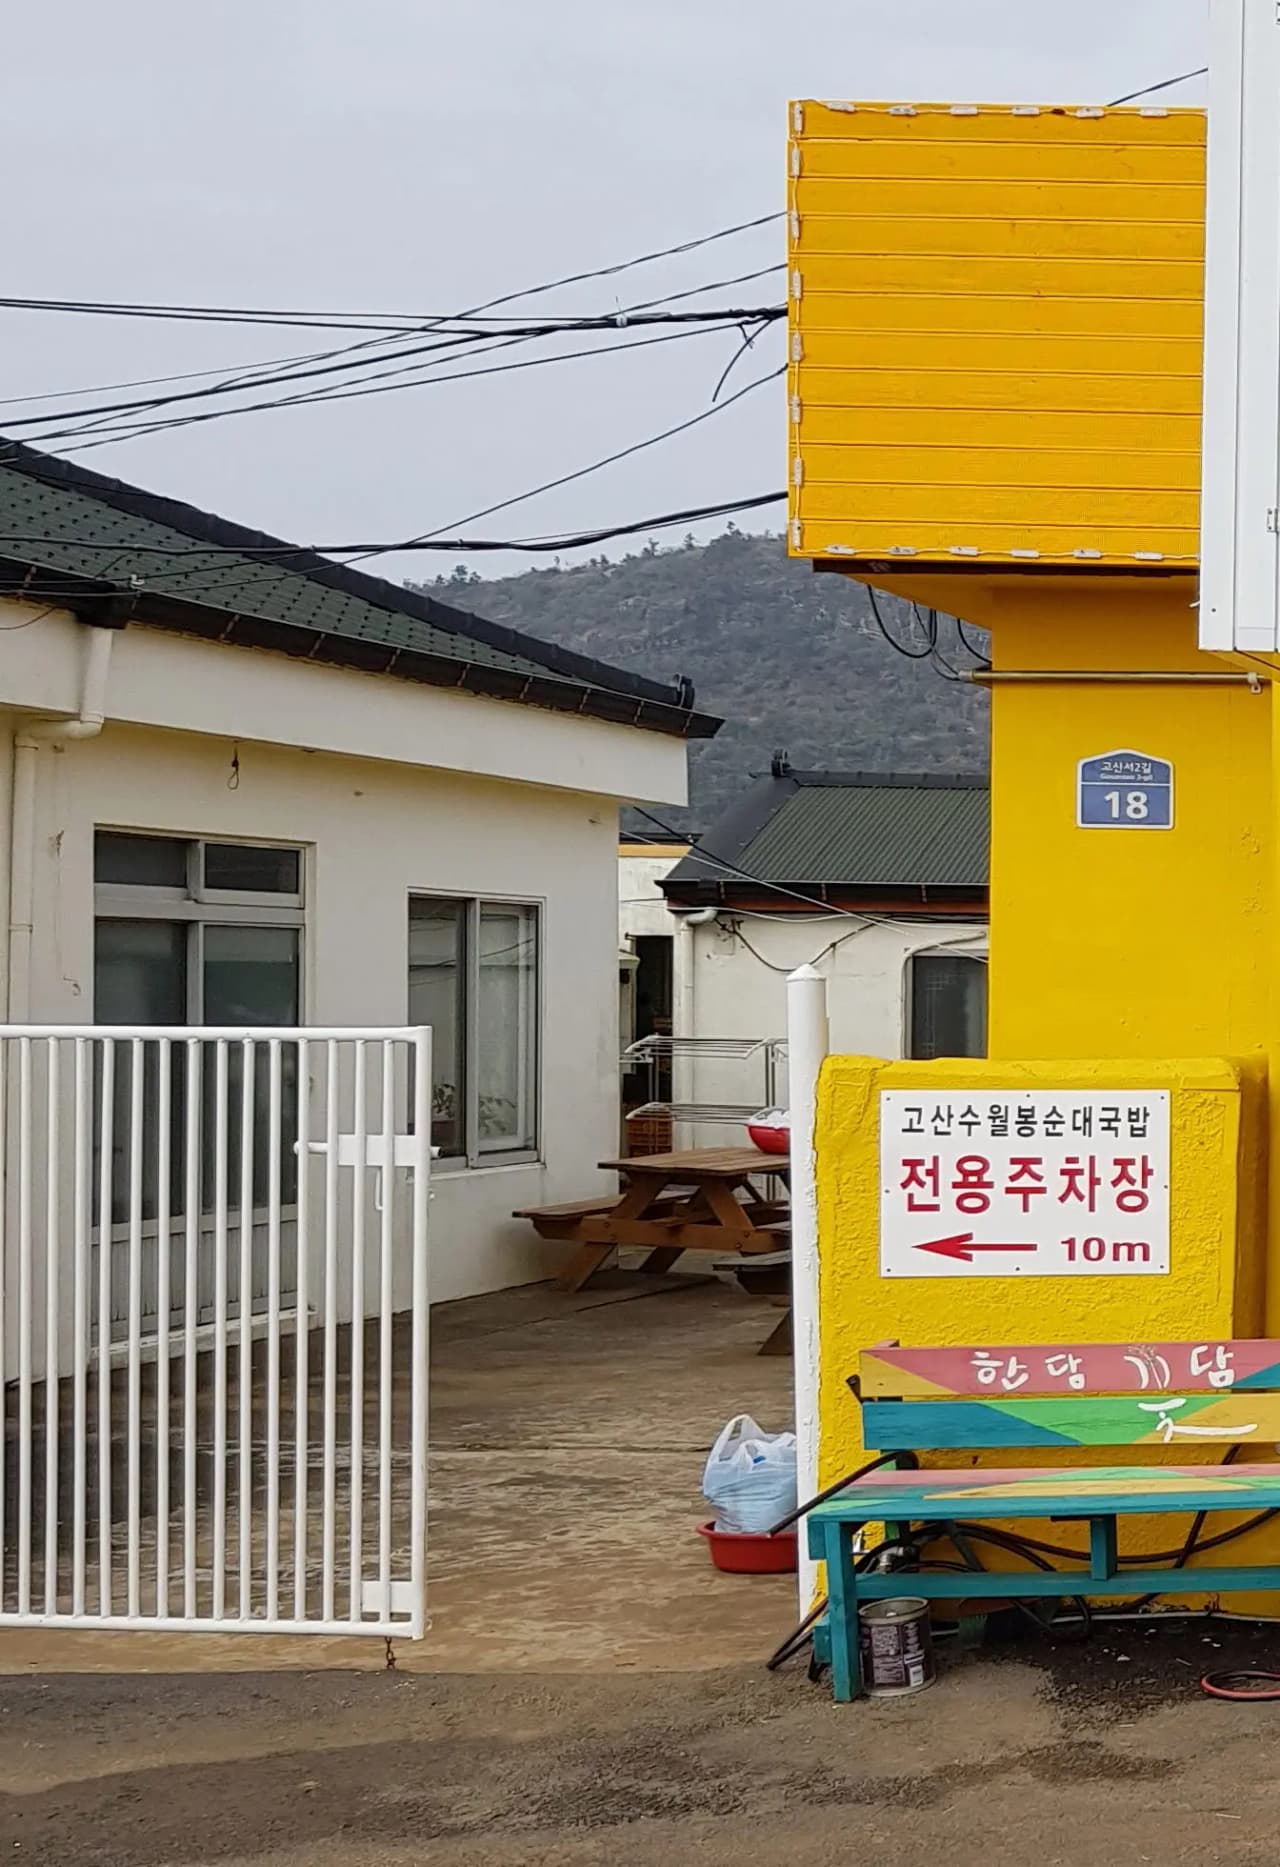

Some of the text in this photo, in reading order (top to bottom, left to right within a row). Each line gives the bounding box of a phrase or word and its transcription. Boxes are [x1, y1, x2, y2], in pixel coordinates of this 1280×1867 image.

[1104, 791, 1149, 819] 18
[901, 1104, 1150, 1138] 고산수월봉순대국밥
[900, 1154, 1154, 1214] 전용주차장
[1060, 1237, 1151, 1263] 10m
